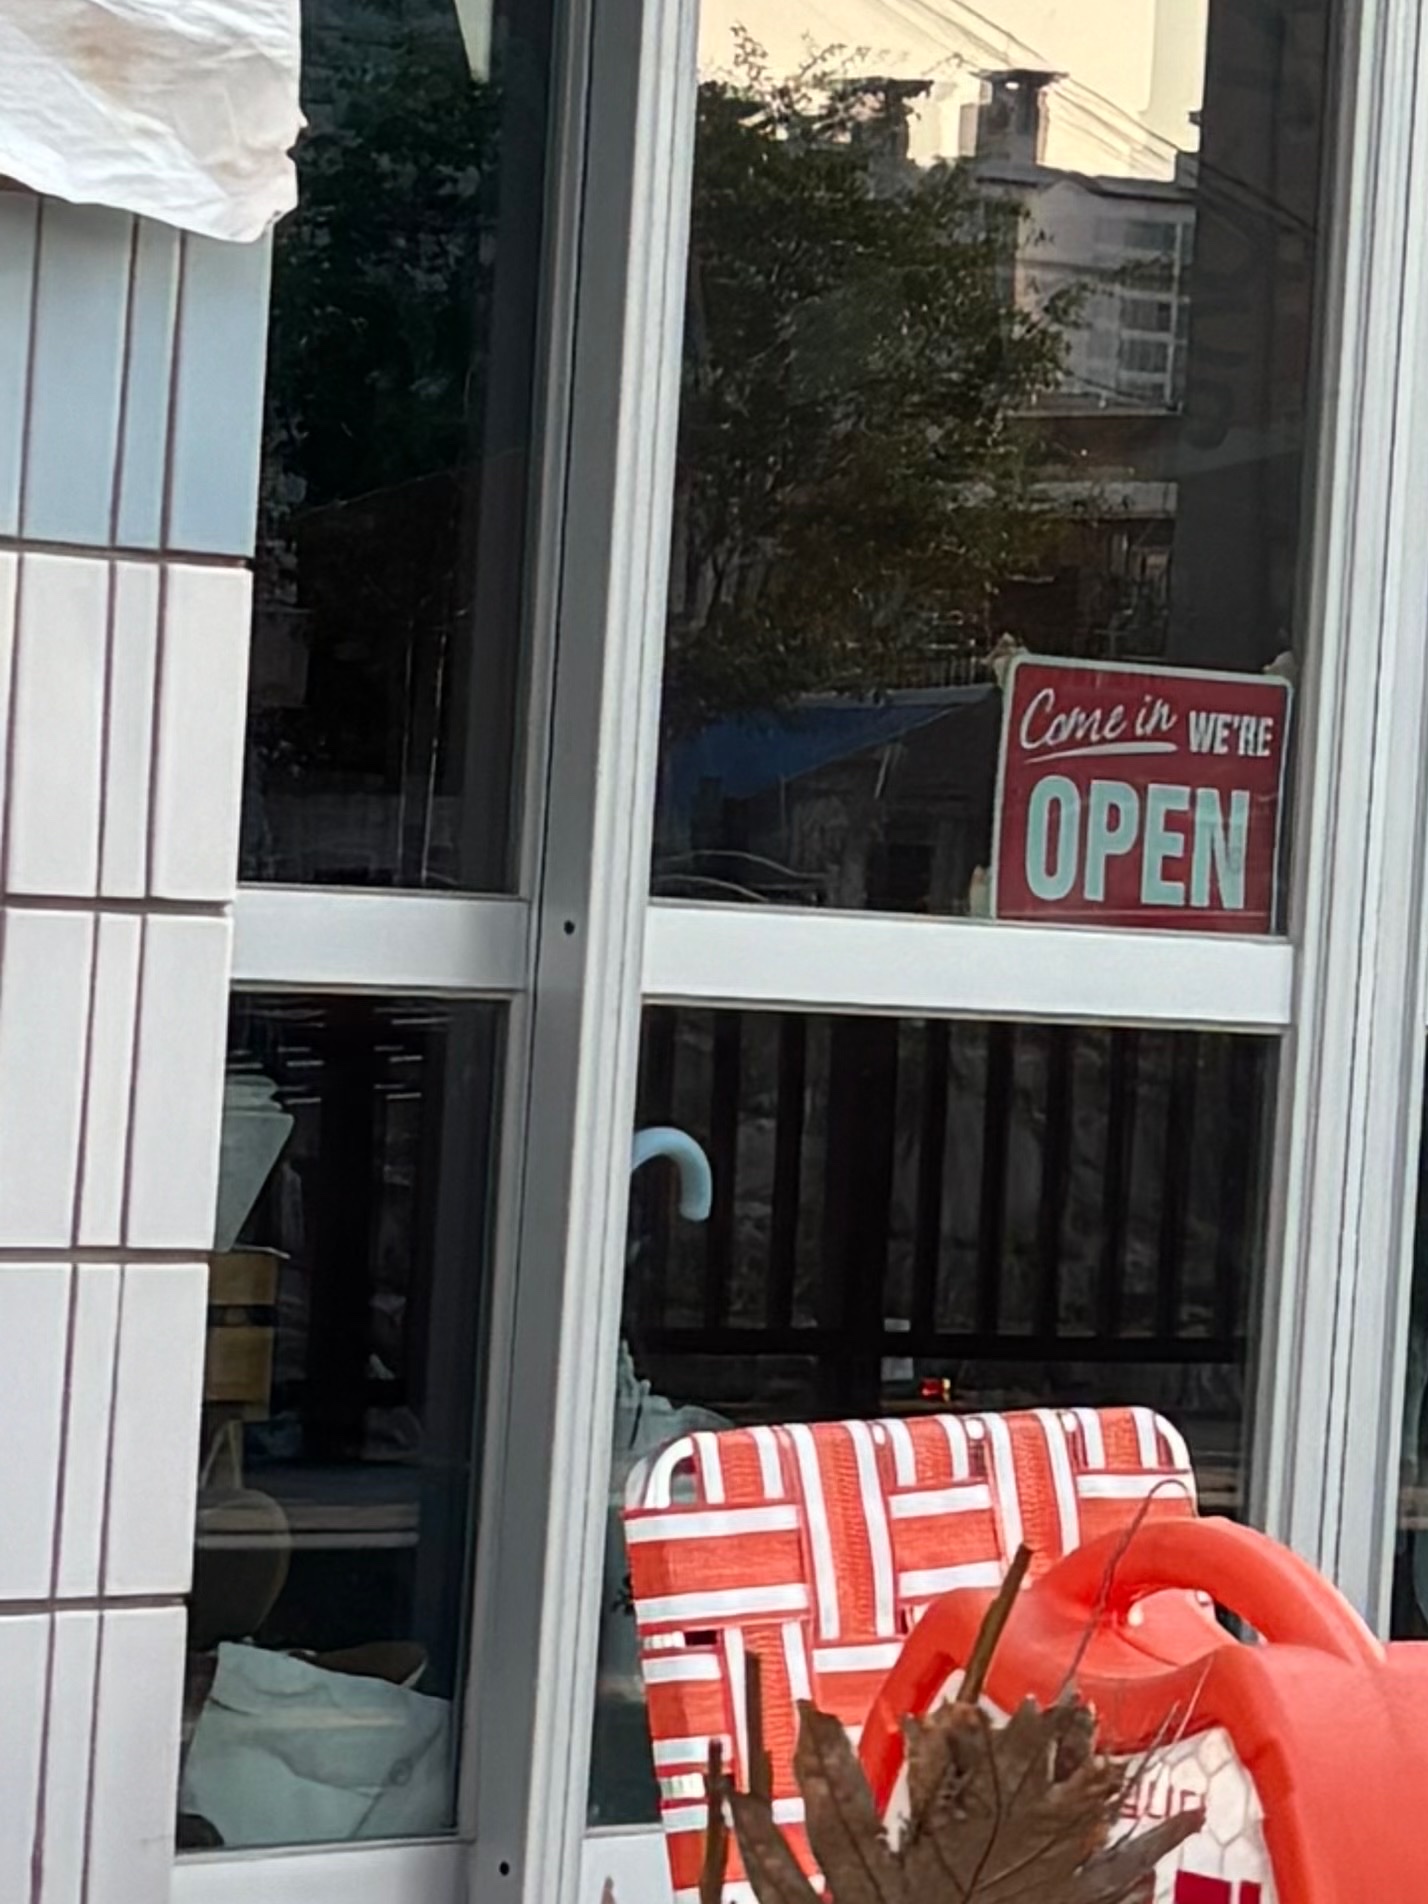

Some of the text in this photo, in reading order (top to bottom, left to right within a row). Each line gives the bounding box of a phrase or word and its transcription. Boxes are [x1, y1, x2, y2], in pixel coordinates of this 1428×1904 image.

[1020, 688, 1275, 757] Come in WE'RE
[1025, 774, 1250, 909] OPEN
